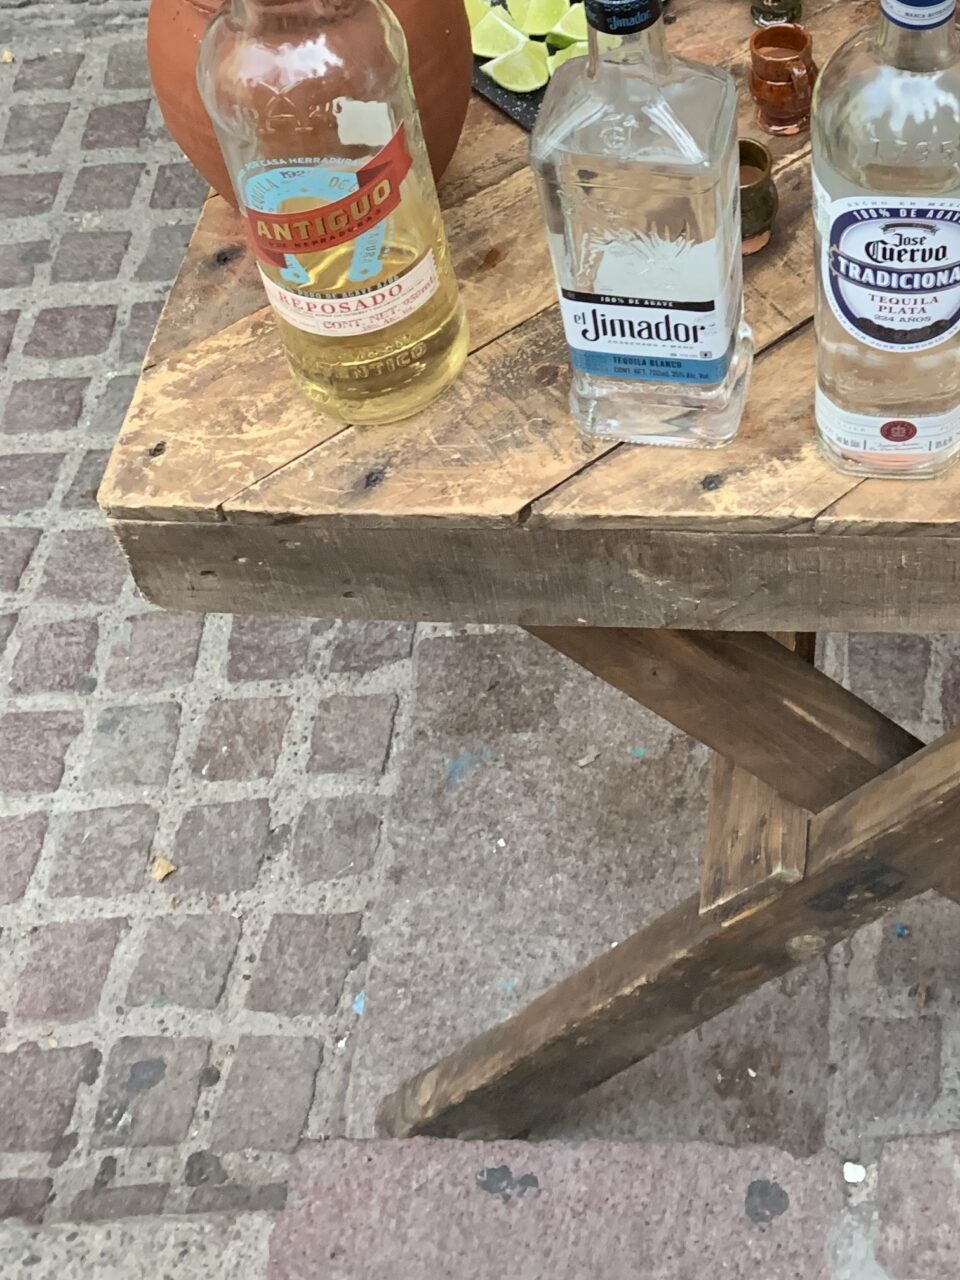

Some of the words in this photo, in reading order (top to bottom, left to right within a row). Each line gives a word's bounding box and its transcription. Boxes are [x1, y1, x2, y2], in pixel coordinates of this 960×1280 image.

[609, 10, 651, 31] Jimador
[261, 158, 288, 168] CASA
[289, 156, 361, 167] HERRADURA
[254, 177, 280, 211] EQUILA
[256, 179, 391, 241] ANTIGUO
[852, 207, 890, 221] 100%
[900, 208, 917, 218] DE
[892, 232, 927, 247] Jose
[864, 239, 948, 264] Cuervo
[278, 282, 404, 315] REPOSADO
[643, 299, 674, 308] AGAVE
[868, 293, 940, 306] TEQUILA
[878, 305, 927, 315] PLATA
[573, 311, 586, 325] el
[581, 308, 706, 343] Jimador
[612, 356, 647, 367] TEQUILA
[649, 359, 682, 369] BLANCO
